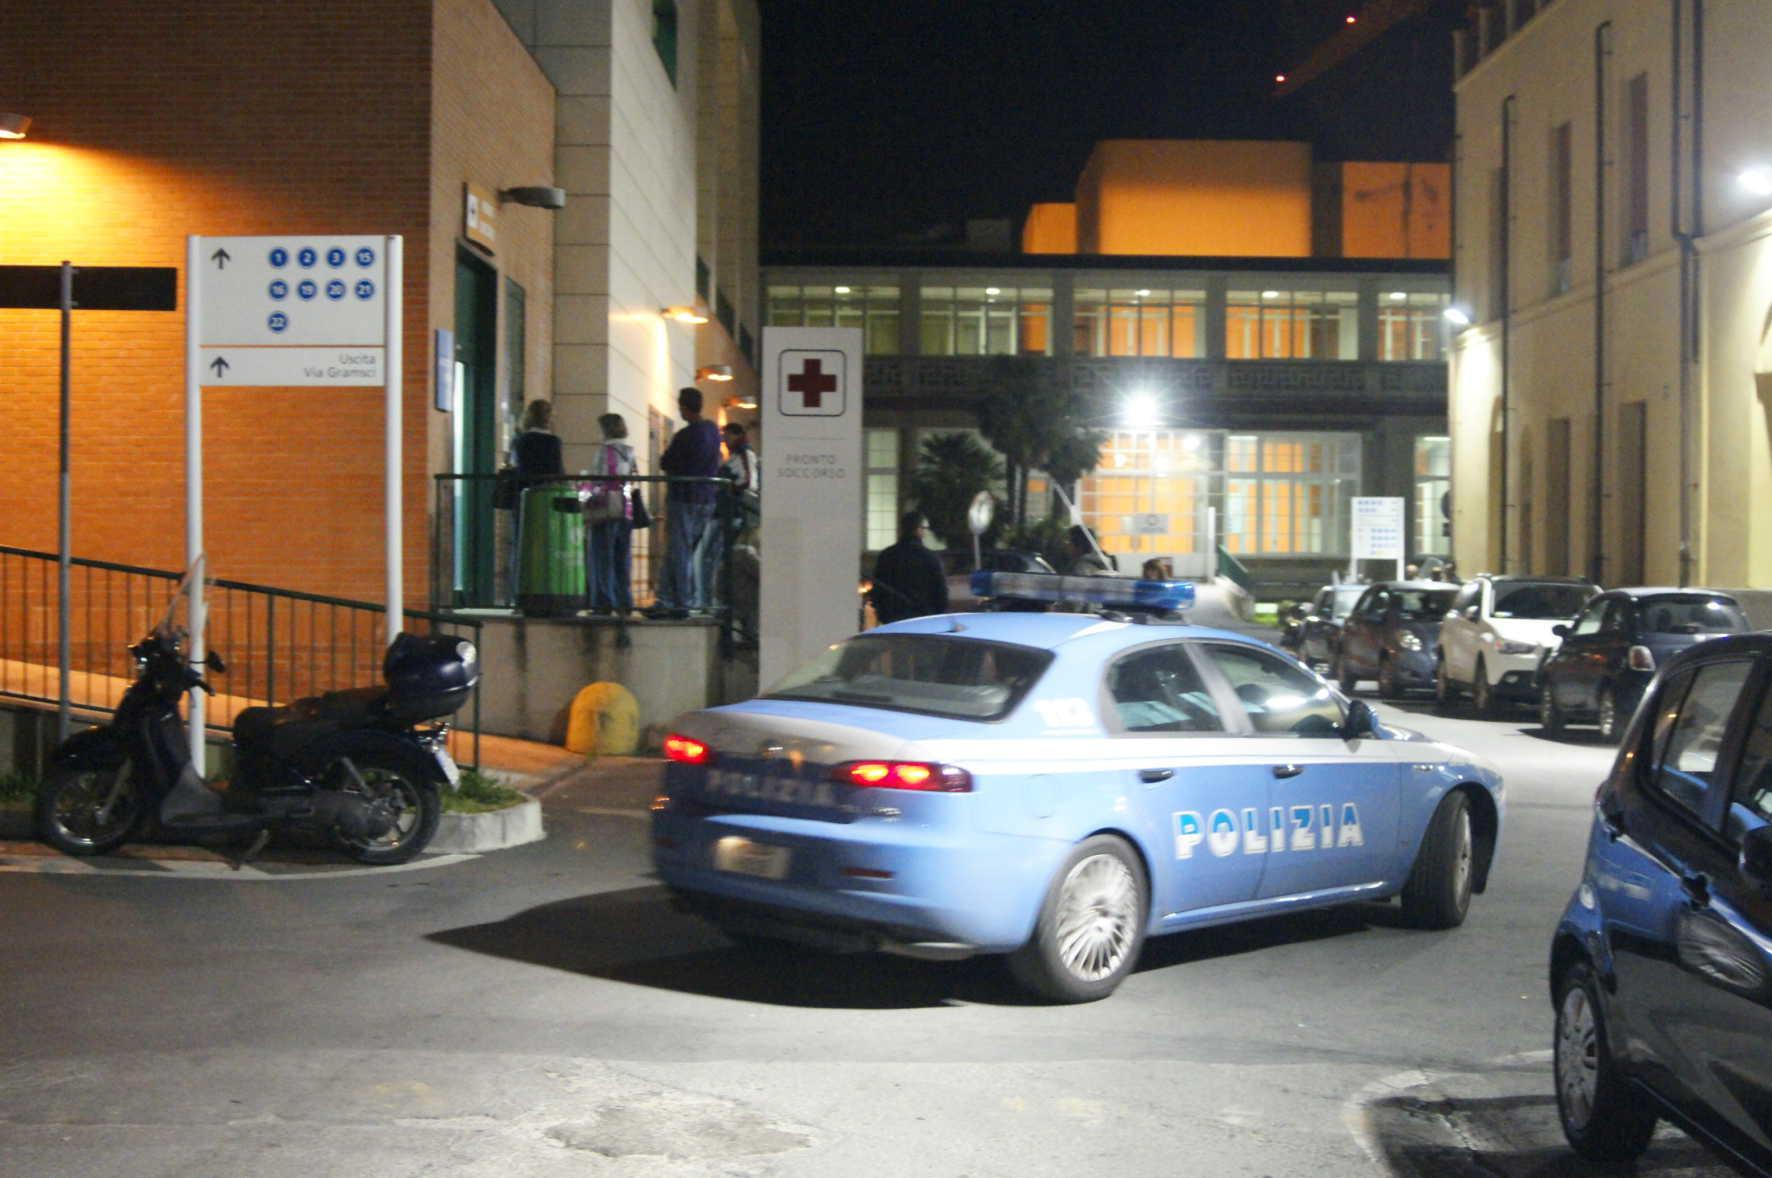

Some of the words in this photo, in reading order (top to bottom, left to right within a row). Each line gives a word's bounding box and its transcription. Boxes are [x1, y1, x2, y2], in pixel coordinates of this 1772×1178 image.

[338, 353, 376, 365] Uscita
[304, 366, 323, 378] Via
[327, 366, 376, 378] Gramsci
[785, 454, 837, 465] PRONTO
[776, 468, 846, 479] SOCCORSO
[1171, 802, 1365, 860] POLIZIA
